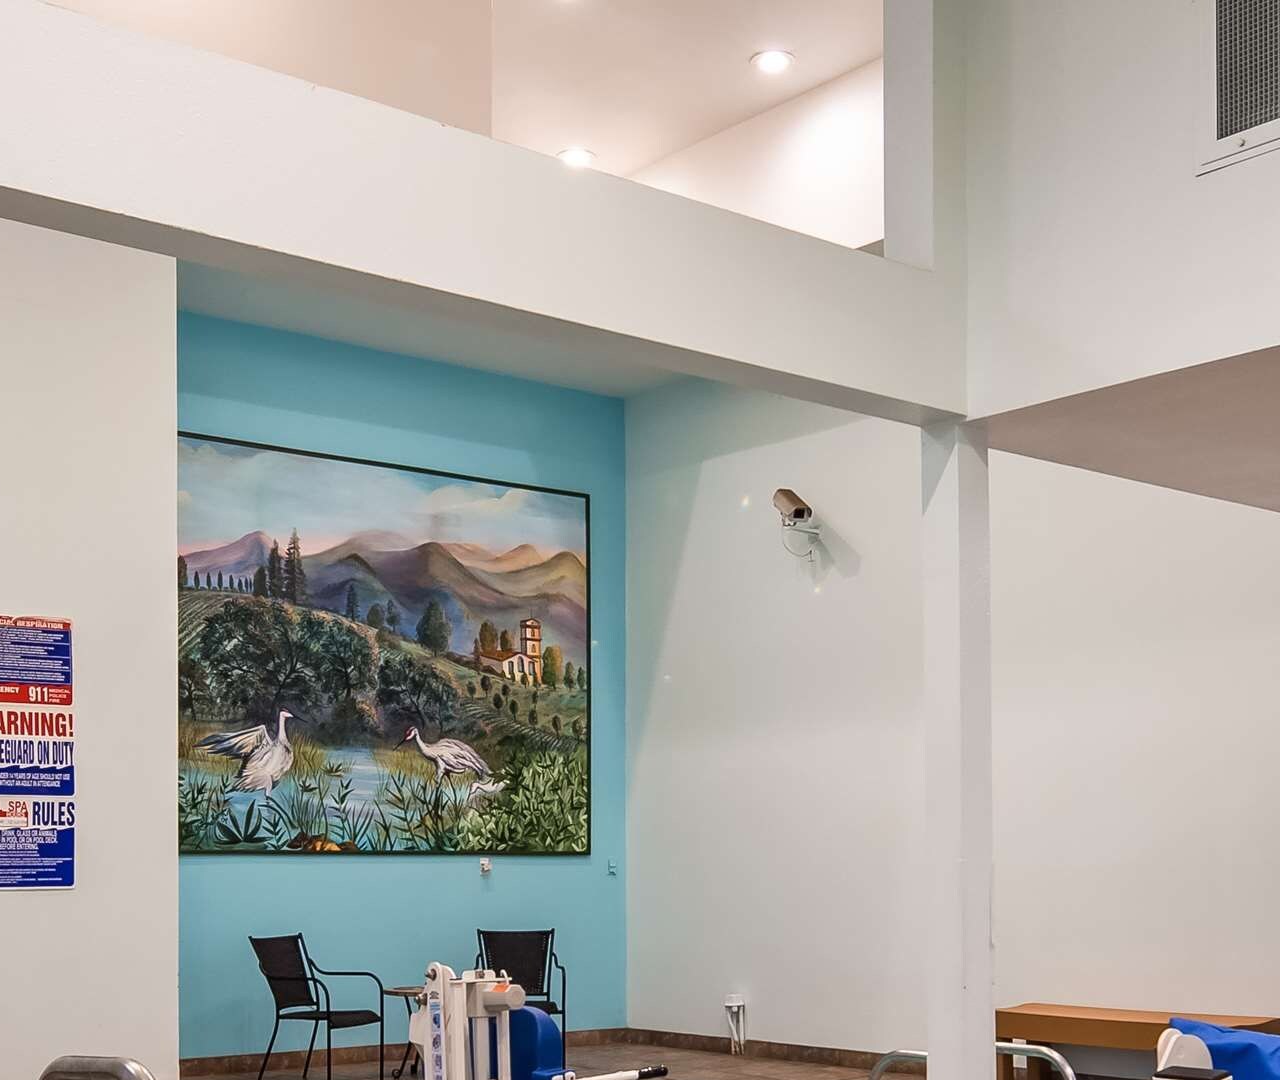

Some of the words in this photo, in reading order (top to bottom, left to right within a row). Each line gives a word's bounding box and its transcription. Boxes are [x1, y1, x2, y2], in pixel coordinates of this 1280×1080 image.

[16, 620, 64, 630] RESPIRATION
[28, 686, 49, 702] 911
[37, 740, 50, 765] ON
[52, 741, 75, 766] DUTY
[8, 801, 27, 812] SPA
[32, 801, 75, 826] RULES
